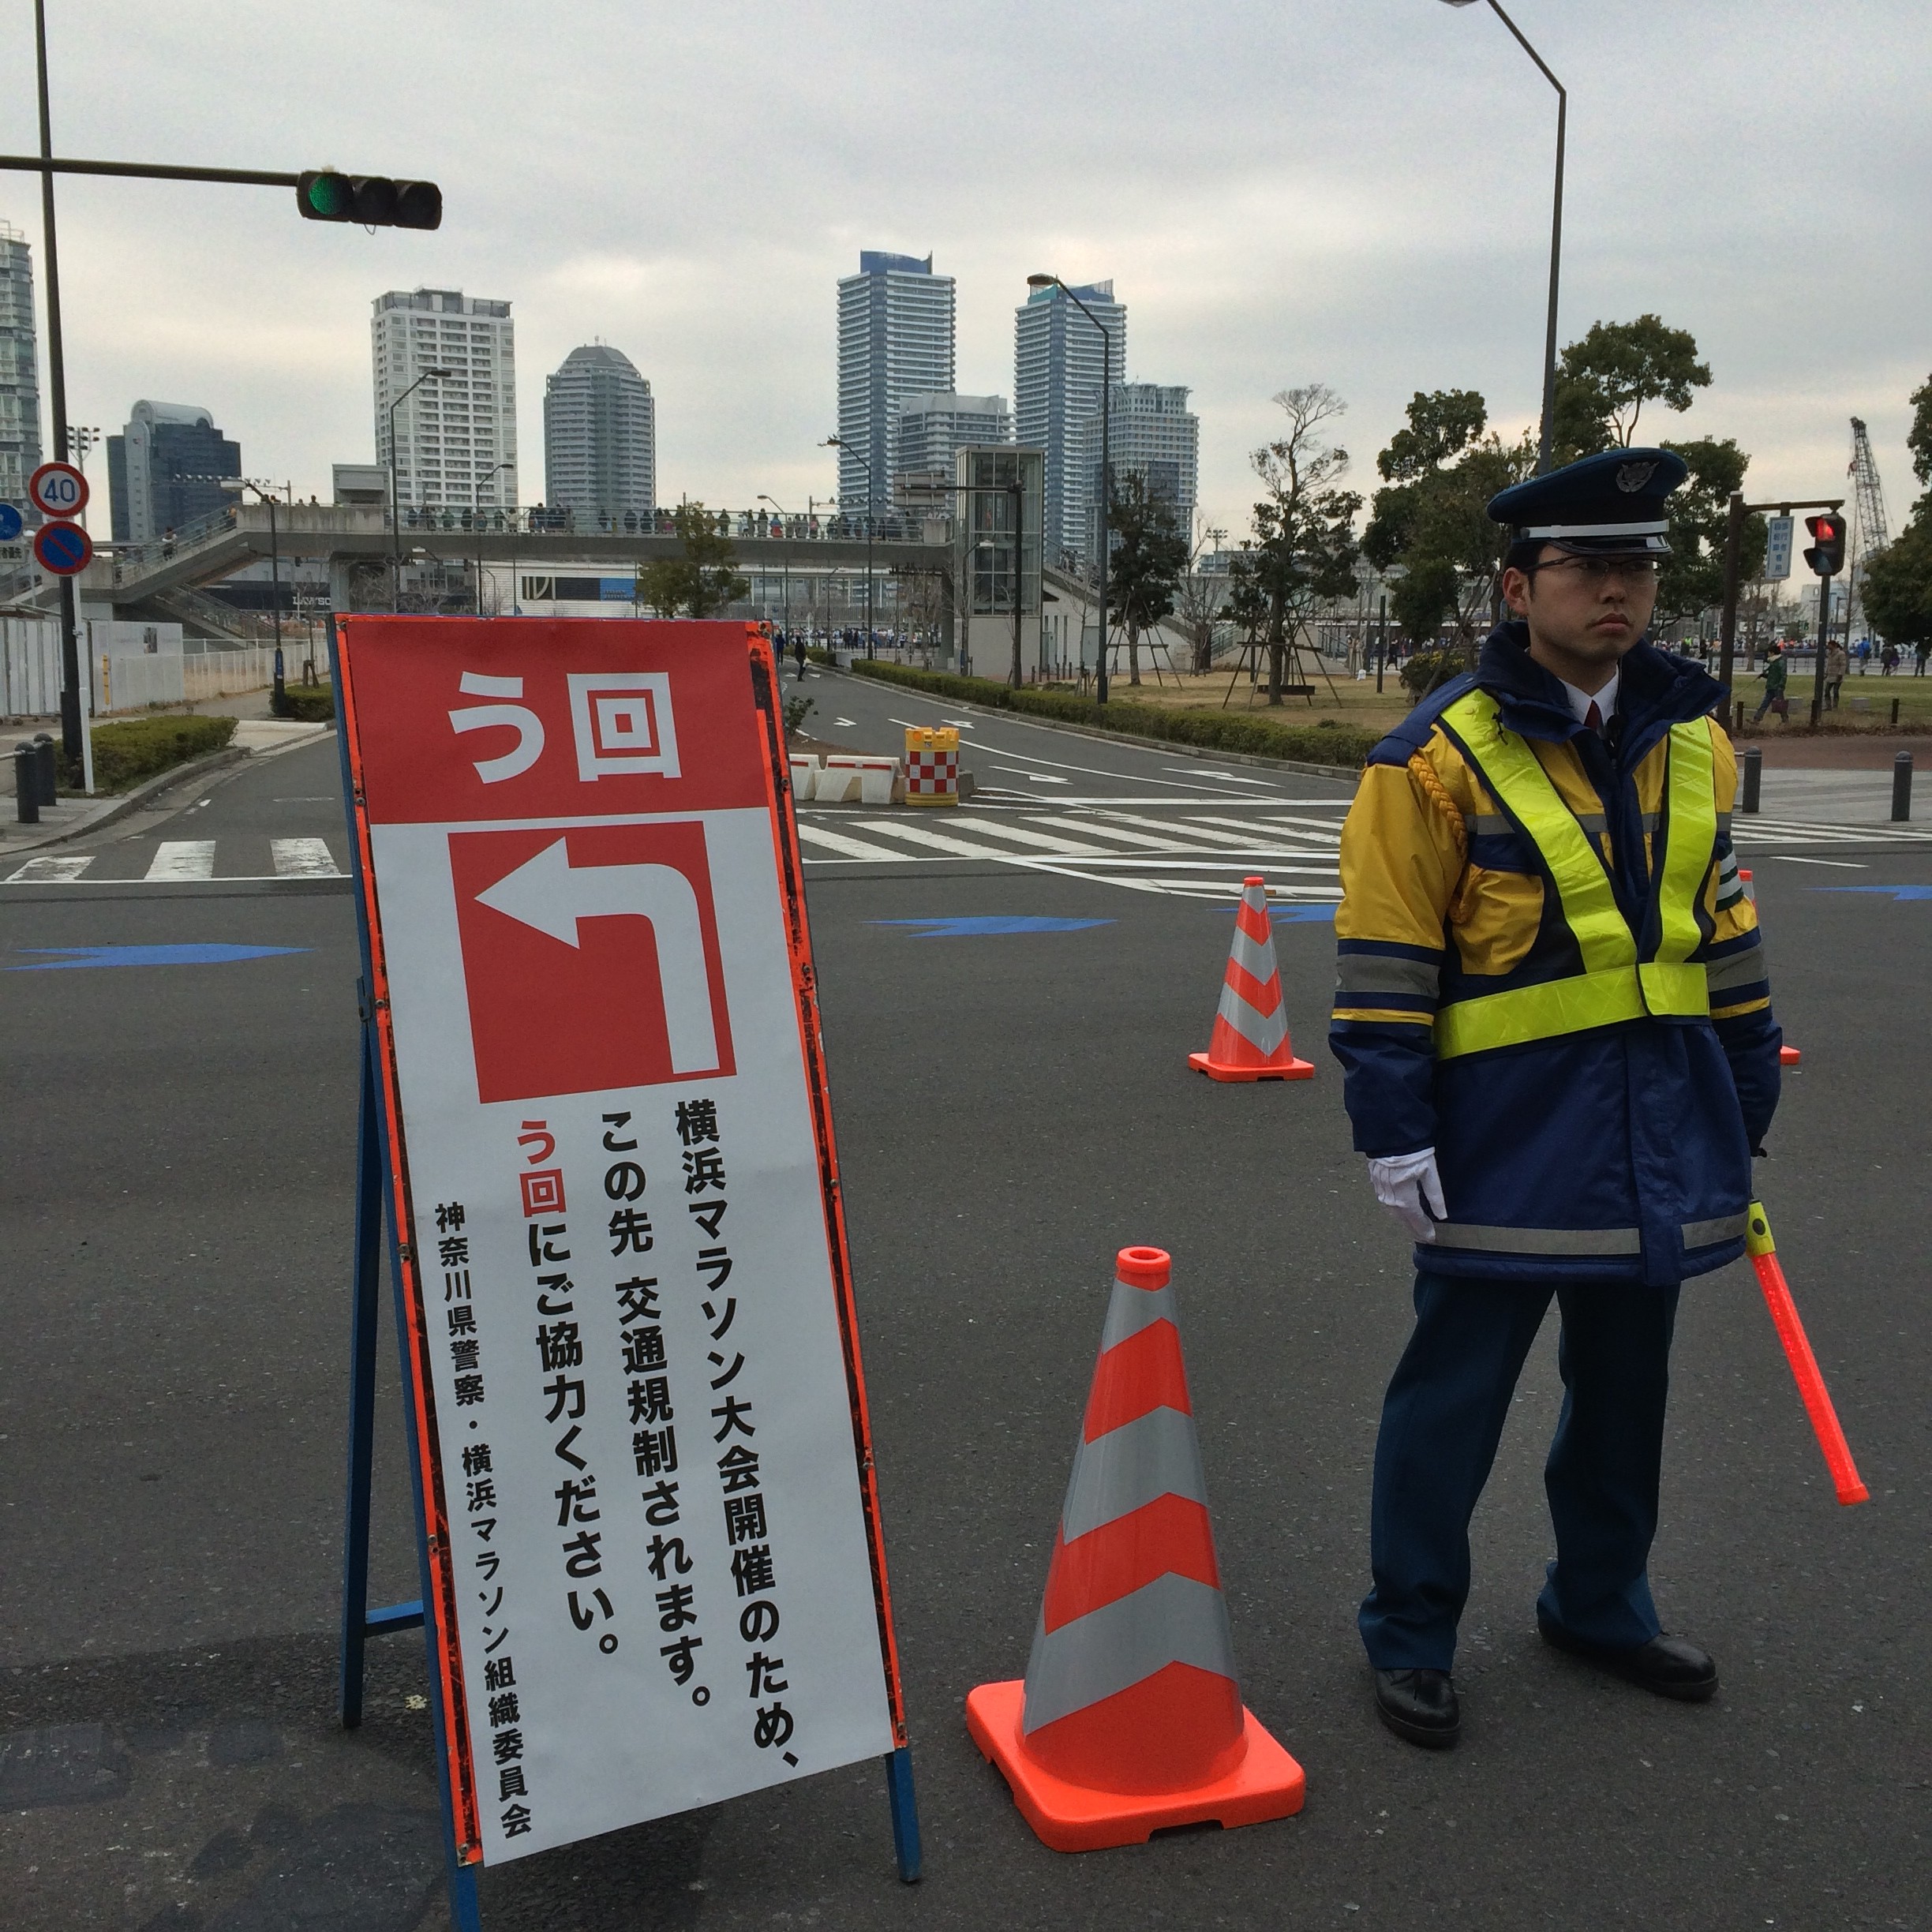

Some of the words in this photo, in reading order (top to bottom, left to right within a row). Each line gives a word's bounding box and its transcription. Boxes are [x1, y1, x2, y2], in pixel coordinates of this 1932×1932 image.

[44, 478, 75, 503] 40
[448, 671, 683, 784] う回
[517, 1119, 618, 1654] う回にご協力ください。
[602, 1111, 653, 1257] この先
[435, 1202, 531, 1839] 神奈川県警察・横浜マラソン組織委員会
[616, 1276, 710, 1706] 交通規制されます。
[675, 1099, 799, 1768] 横浜マラソン大会開催のため、
